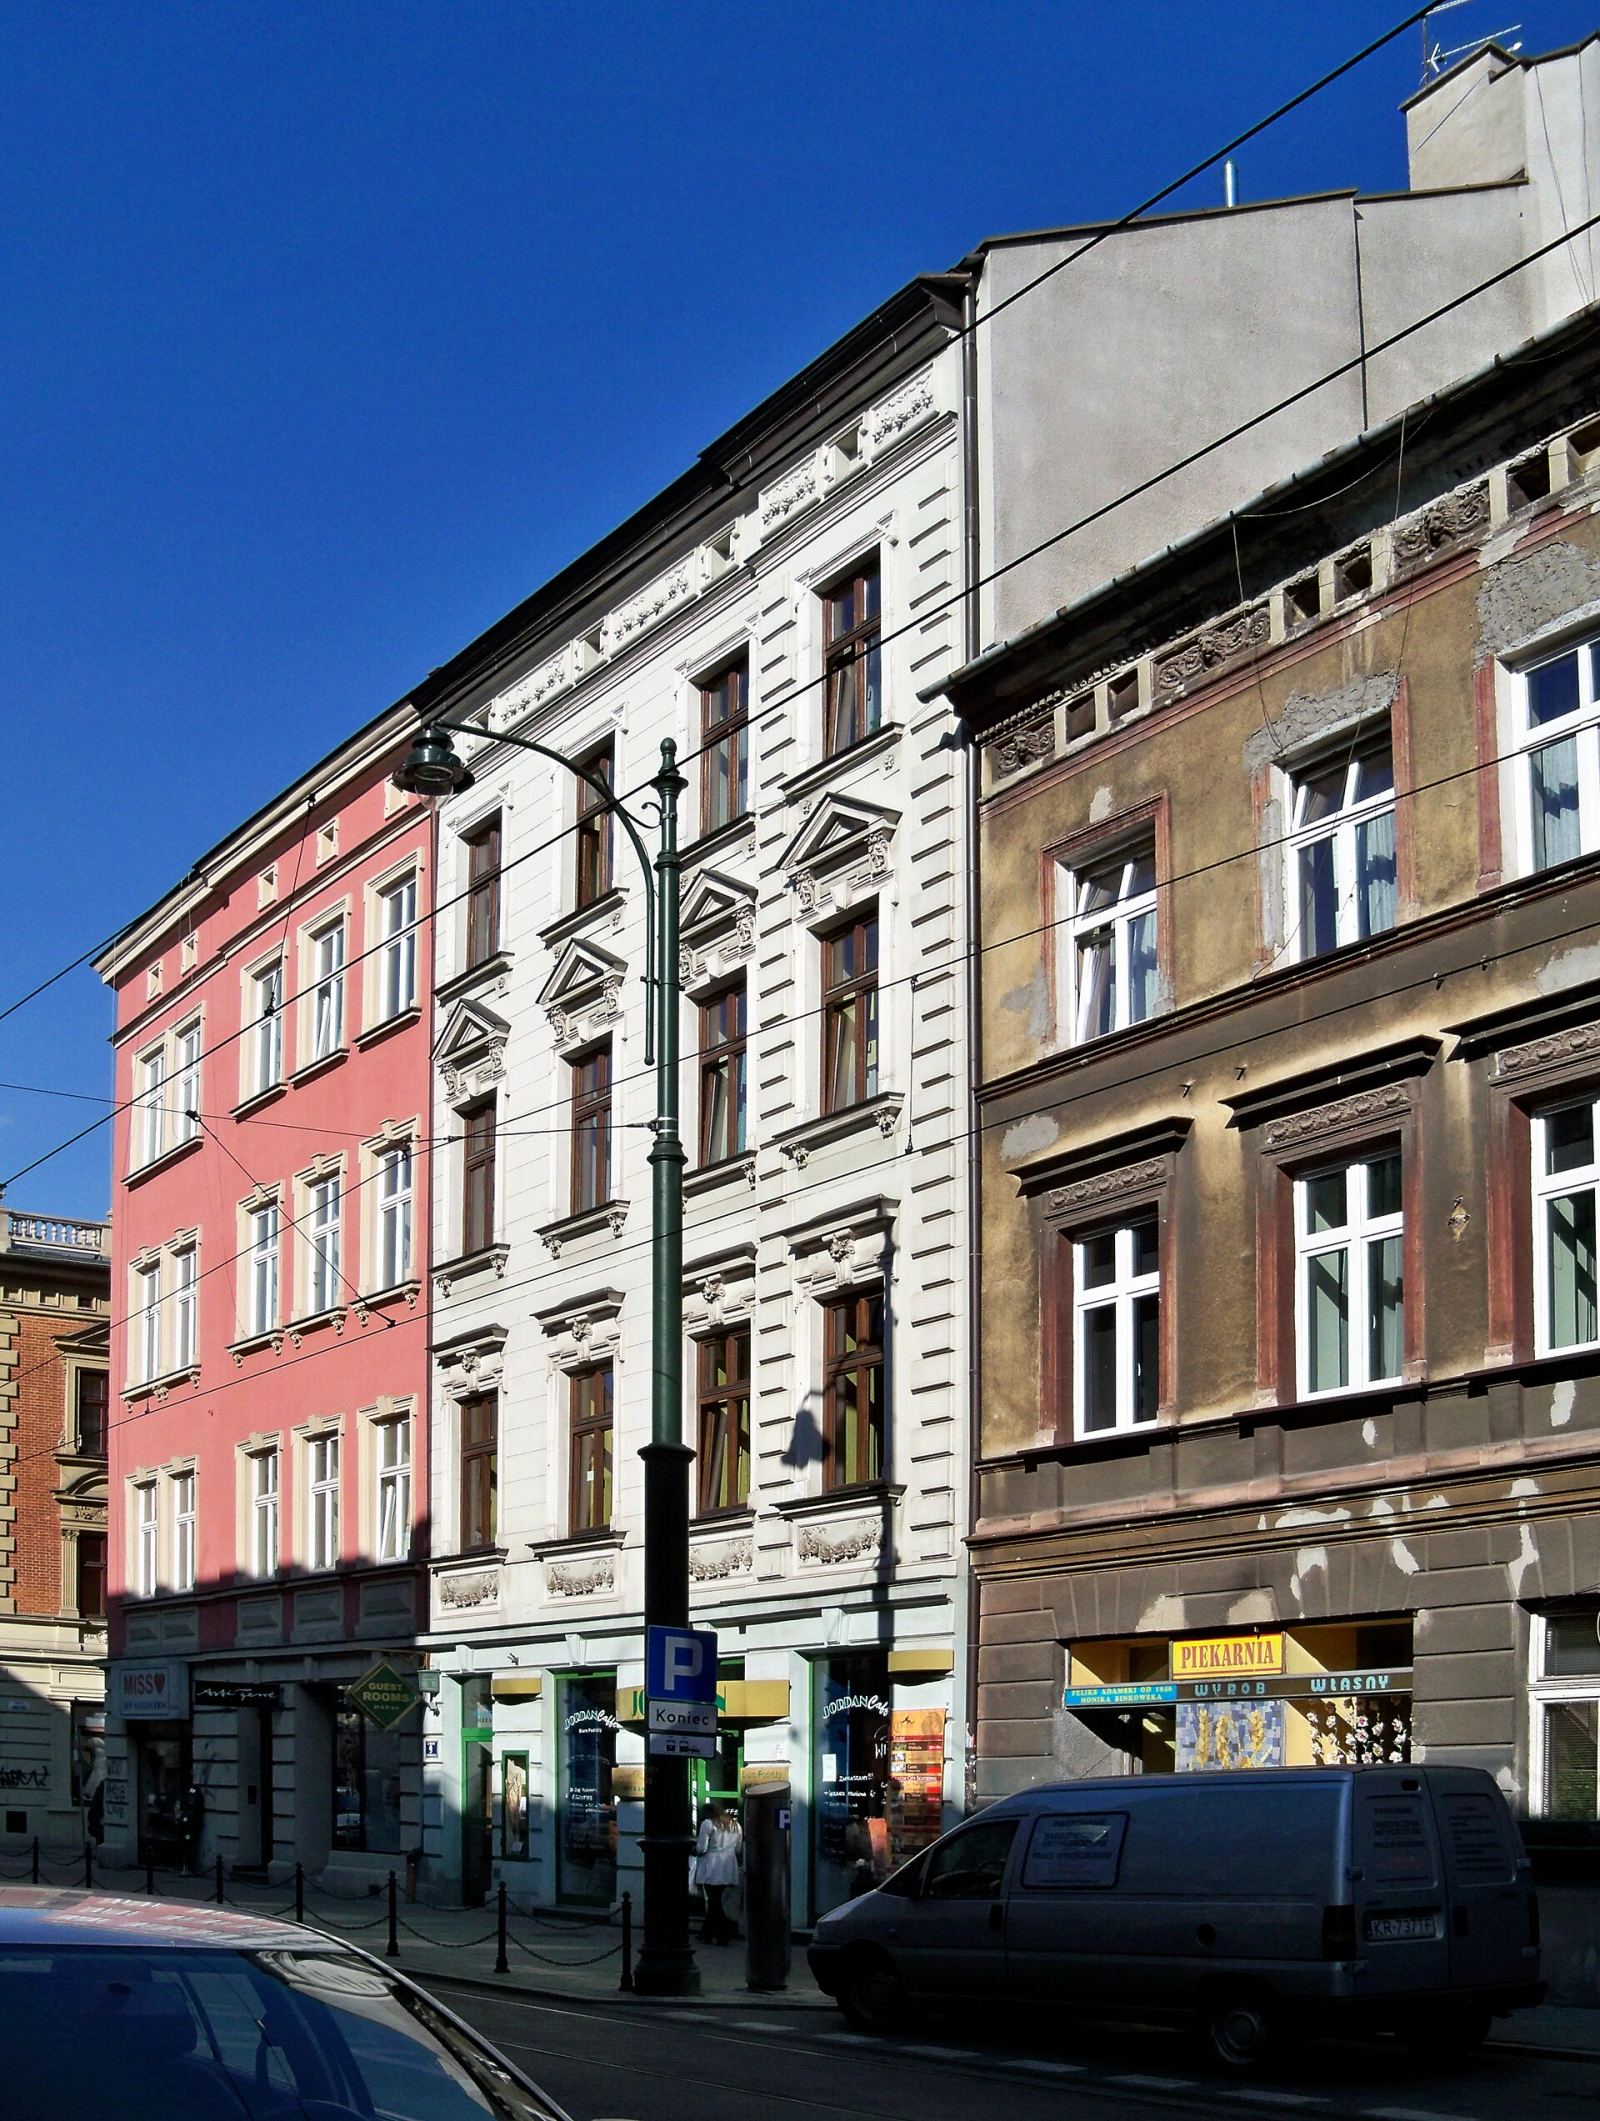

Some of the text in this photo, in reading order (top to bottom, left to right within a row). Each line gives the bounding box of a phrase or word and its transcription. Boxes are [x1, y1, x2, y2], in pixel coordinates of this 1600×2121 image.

[664, 1636, 704, 1691] P
[1181, 1641, 1275, 1669] PIEKARNIA
[124, 1674, 153, 1695] MISS
[368, 1683, 403, 1692] GUEST
[1072, 1689, 1098, 1697] FELIKS
[1102, 1686, 1137, 1695] ADAMSKI
[1140, 1685, 1151, 1693] OD
[362, 1692, 409, 1702] ROOMS
[1080, 1696, 1111, 1704] MONIKA
[823, 1695, 868, 1719] JORDAN
[656, 1709, 709, 1726] Koniec
